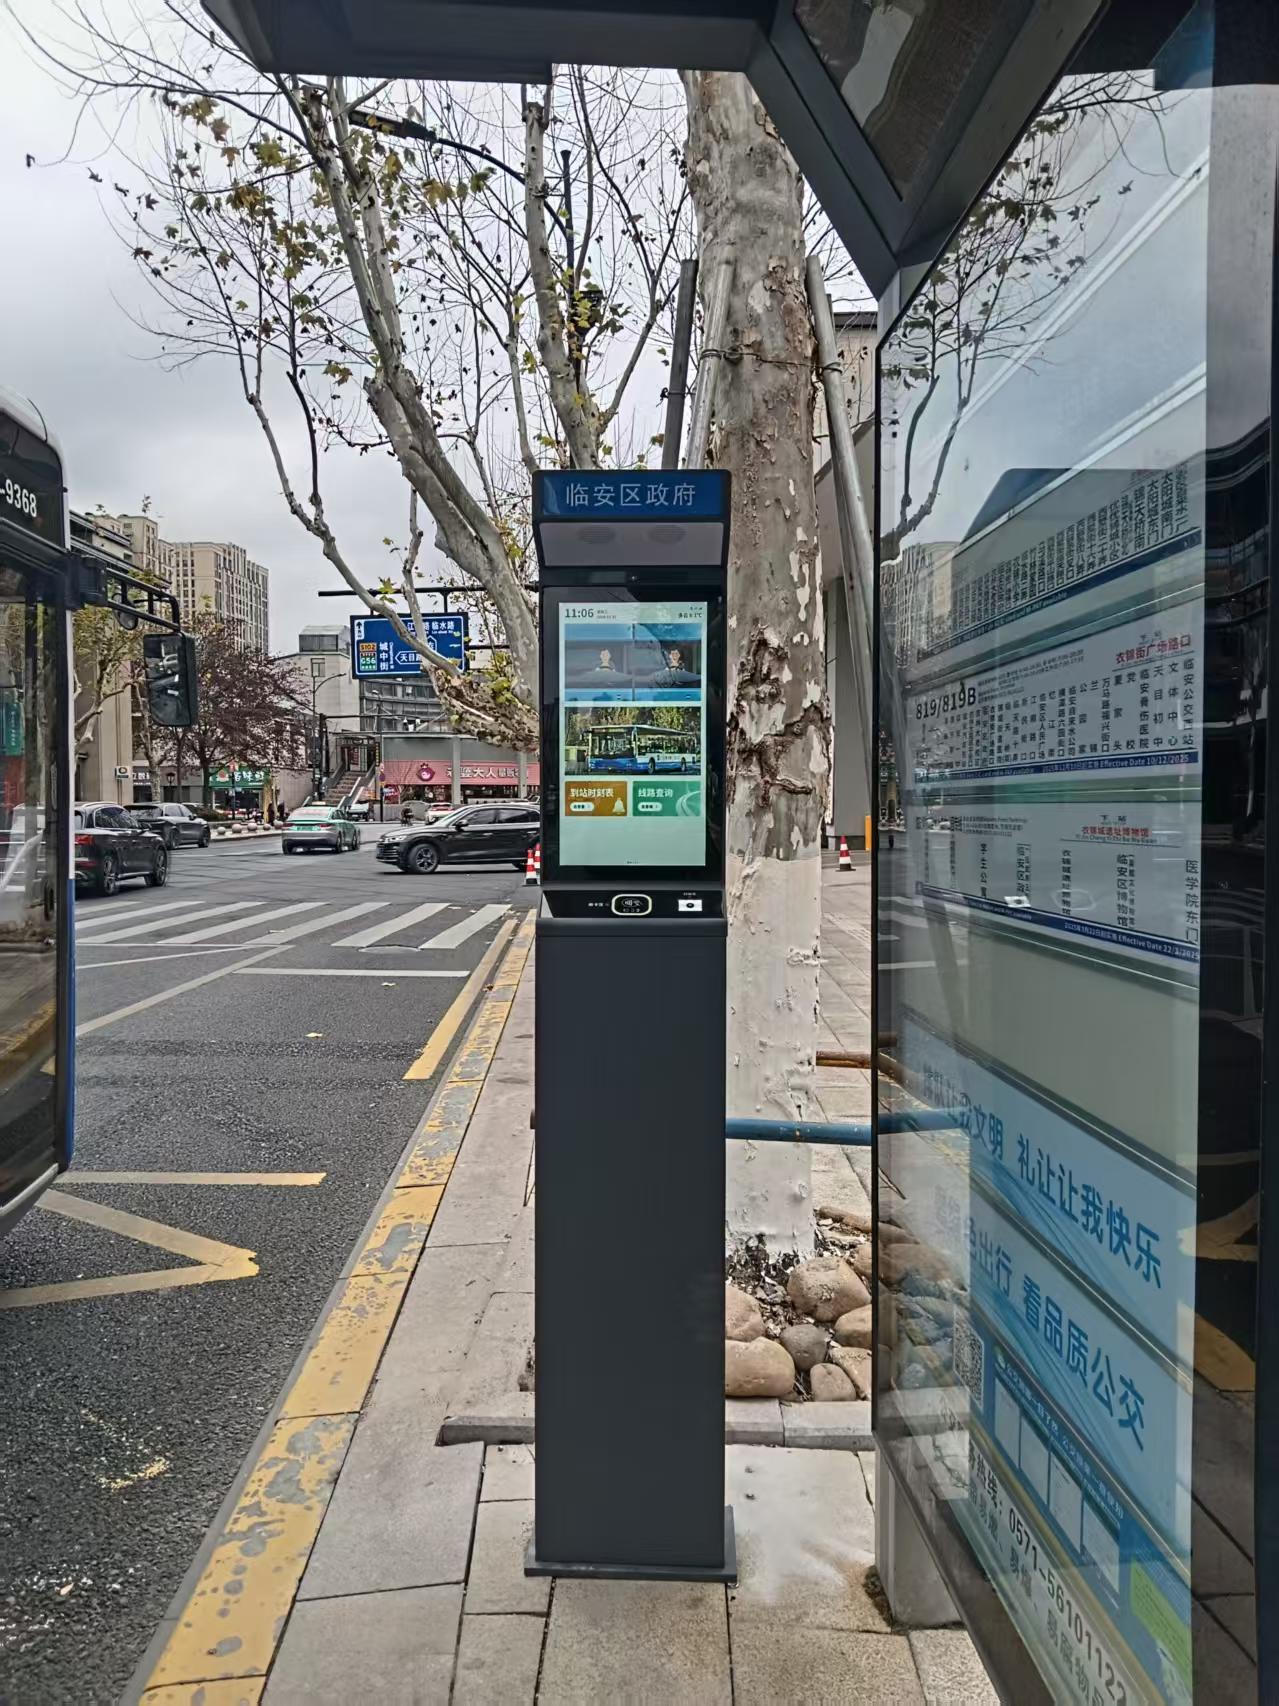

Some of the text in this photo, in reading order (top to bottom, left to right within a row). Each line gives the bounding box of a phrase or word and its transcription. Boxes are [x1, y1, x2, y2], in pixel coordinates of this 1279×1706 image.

[566, 483, 696, 507] 临安区政府
[407, 621, 455, 631] 江路 临水路
[565, 608, 594, 618] 11:06
[1116, 635, 1191, 664] 衣锦街广场路口
[916, 687, 977, 720] 819/819B
[1126, 671, 1136, 750] 党校
[1140, 668, 1150, 749] 临安骨伤医院
[1153, 665, 1164, 747] 天目初中
[1168, 662, 1179, 746] 文体中心
[1183, 658, 1195, 746] 临安公交西站
[1100, 757, 1128, 768] Effective
[1129, 756, 1145, 766] Date
[570, 788, 614, 798] 到站时刻表
[638, 788, 674, 798] 线路查询
[1117, 854, 1128, 927] 临安区博物馆
[1185, 859, 1199, 945] 医学院东门
[1118, 933, 1146, 947] Effective
[1146, 940, 1163, 952] Date
[1017, 1132, 1163, 1289] 礼让让我快乐
[1023, 1274, 1145, 1456] 看品质公交
